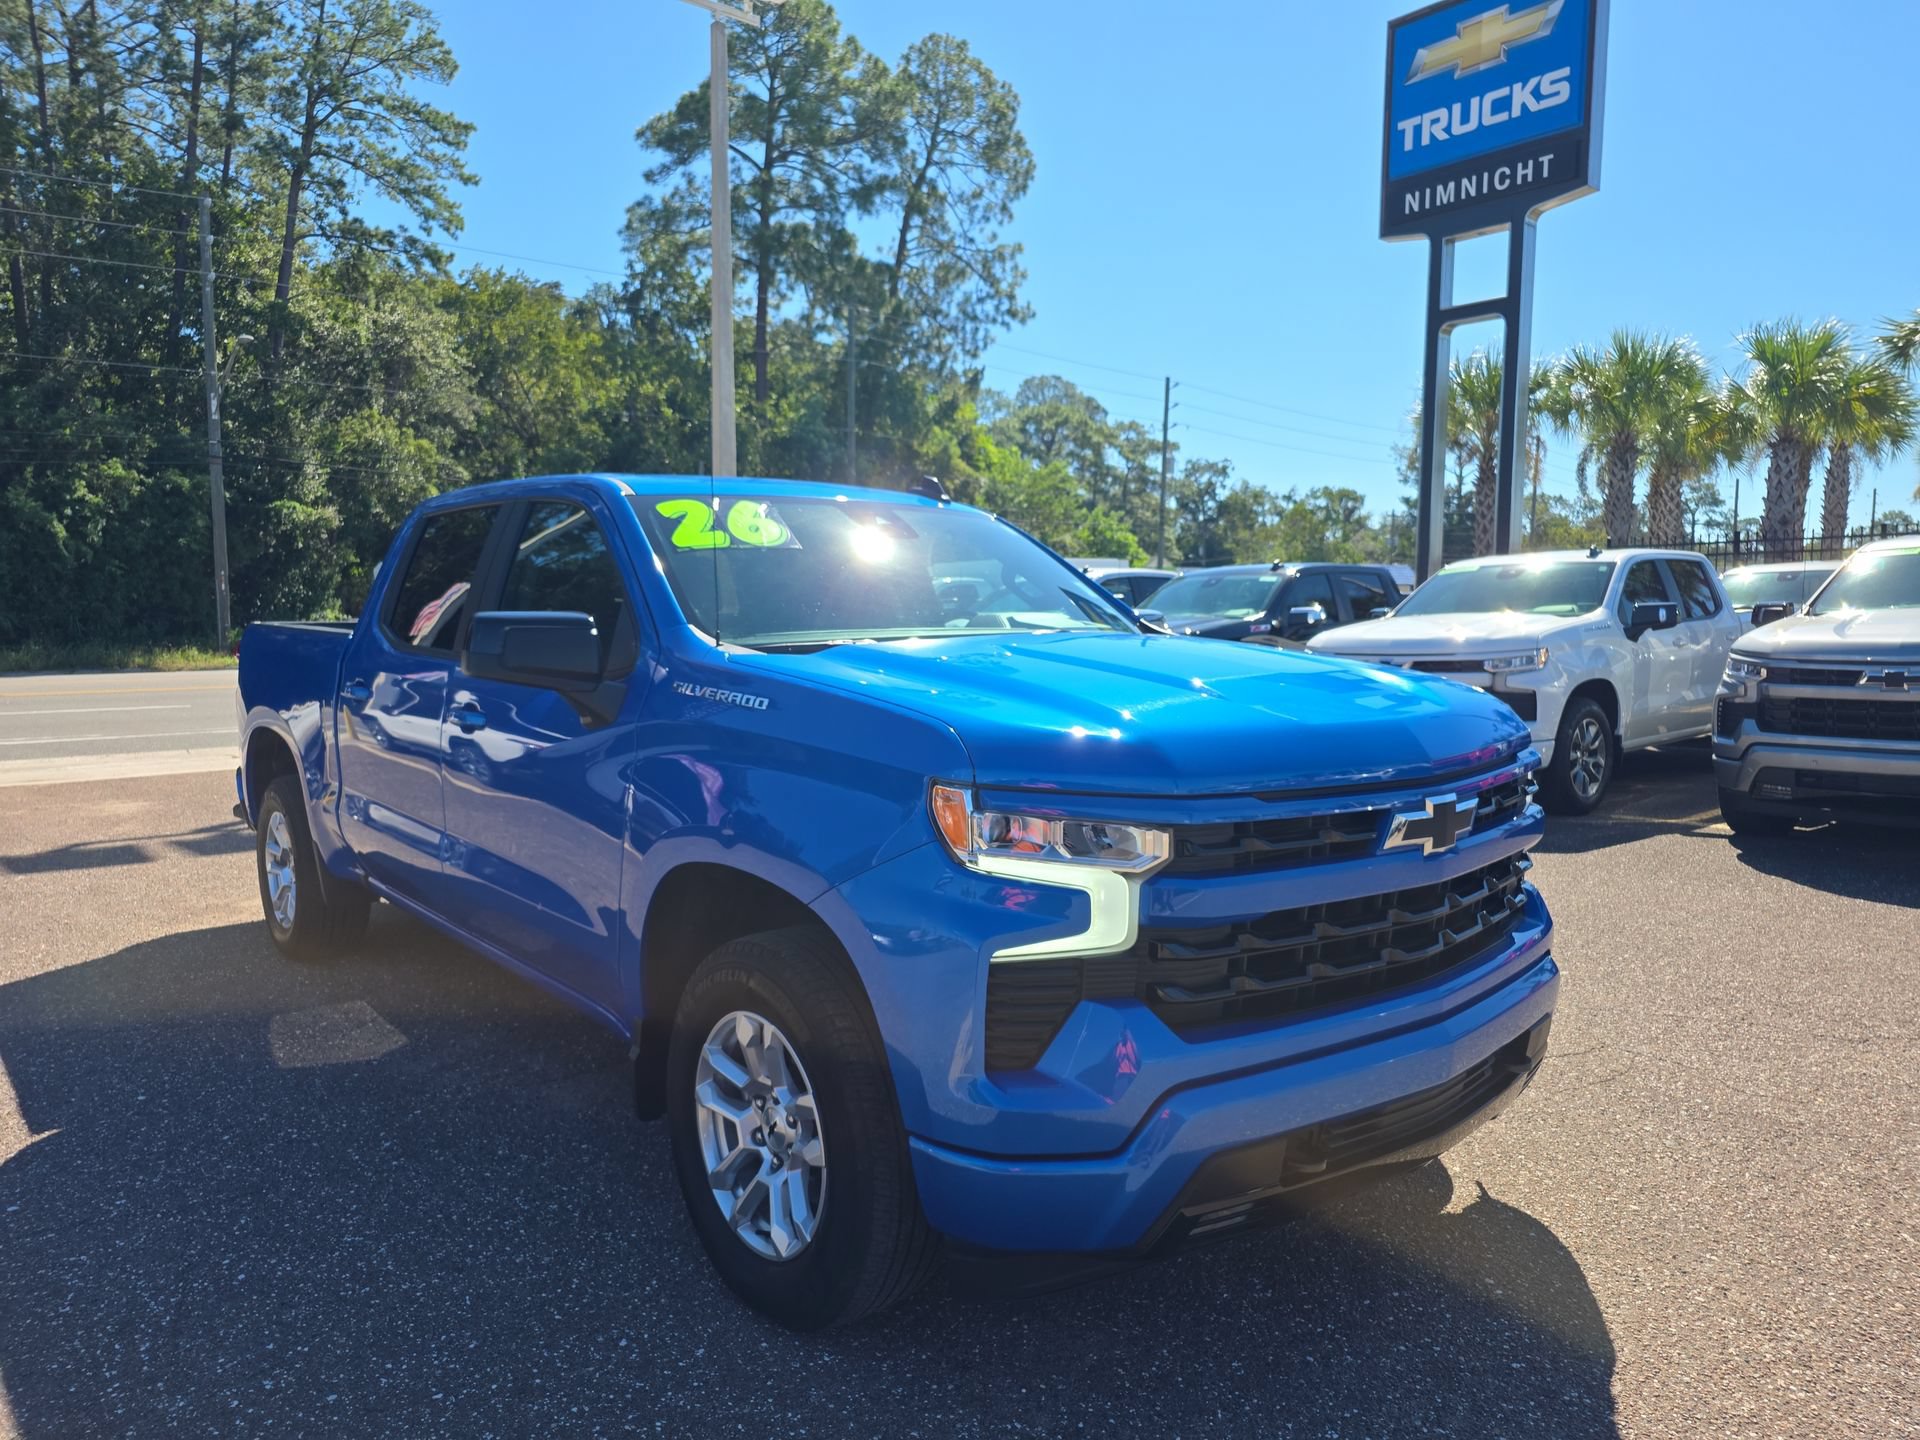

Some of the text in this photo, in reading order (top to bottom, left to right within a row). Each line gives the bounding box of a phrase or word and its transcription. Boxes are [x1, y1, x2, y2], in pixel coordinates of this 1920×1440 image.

[1397, 66, 1571, 152] TRUCKS
[1404, 154, 1554, 215] NIMNICHT
[655, 499, 788, 548] 26
[672, 681, 770, 710] SILVERADO
